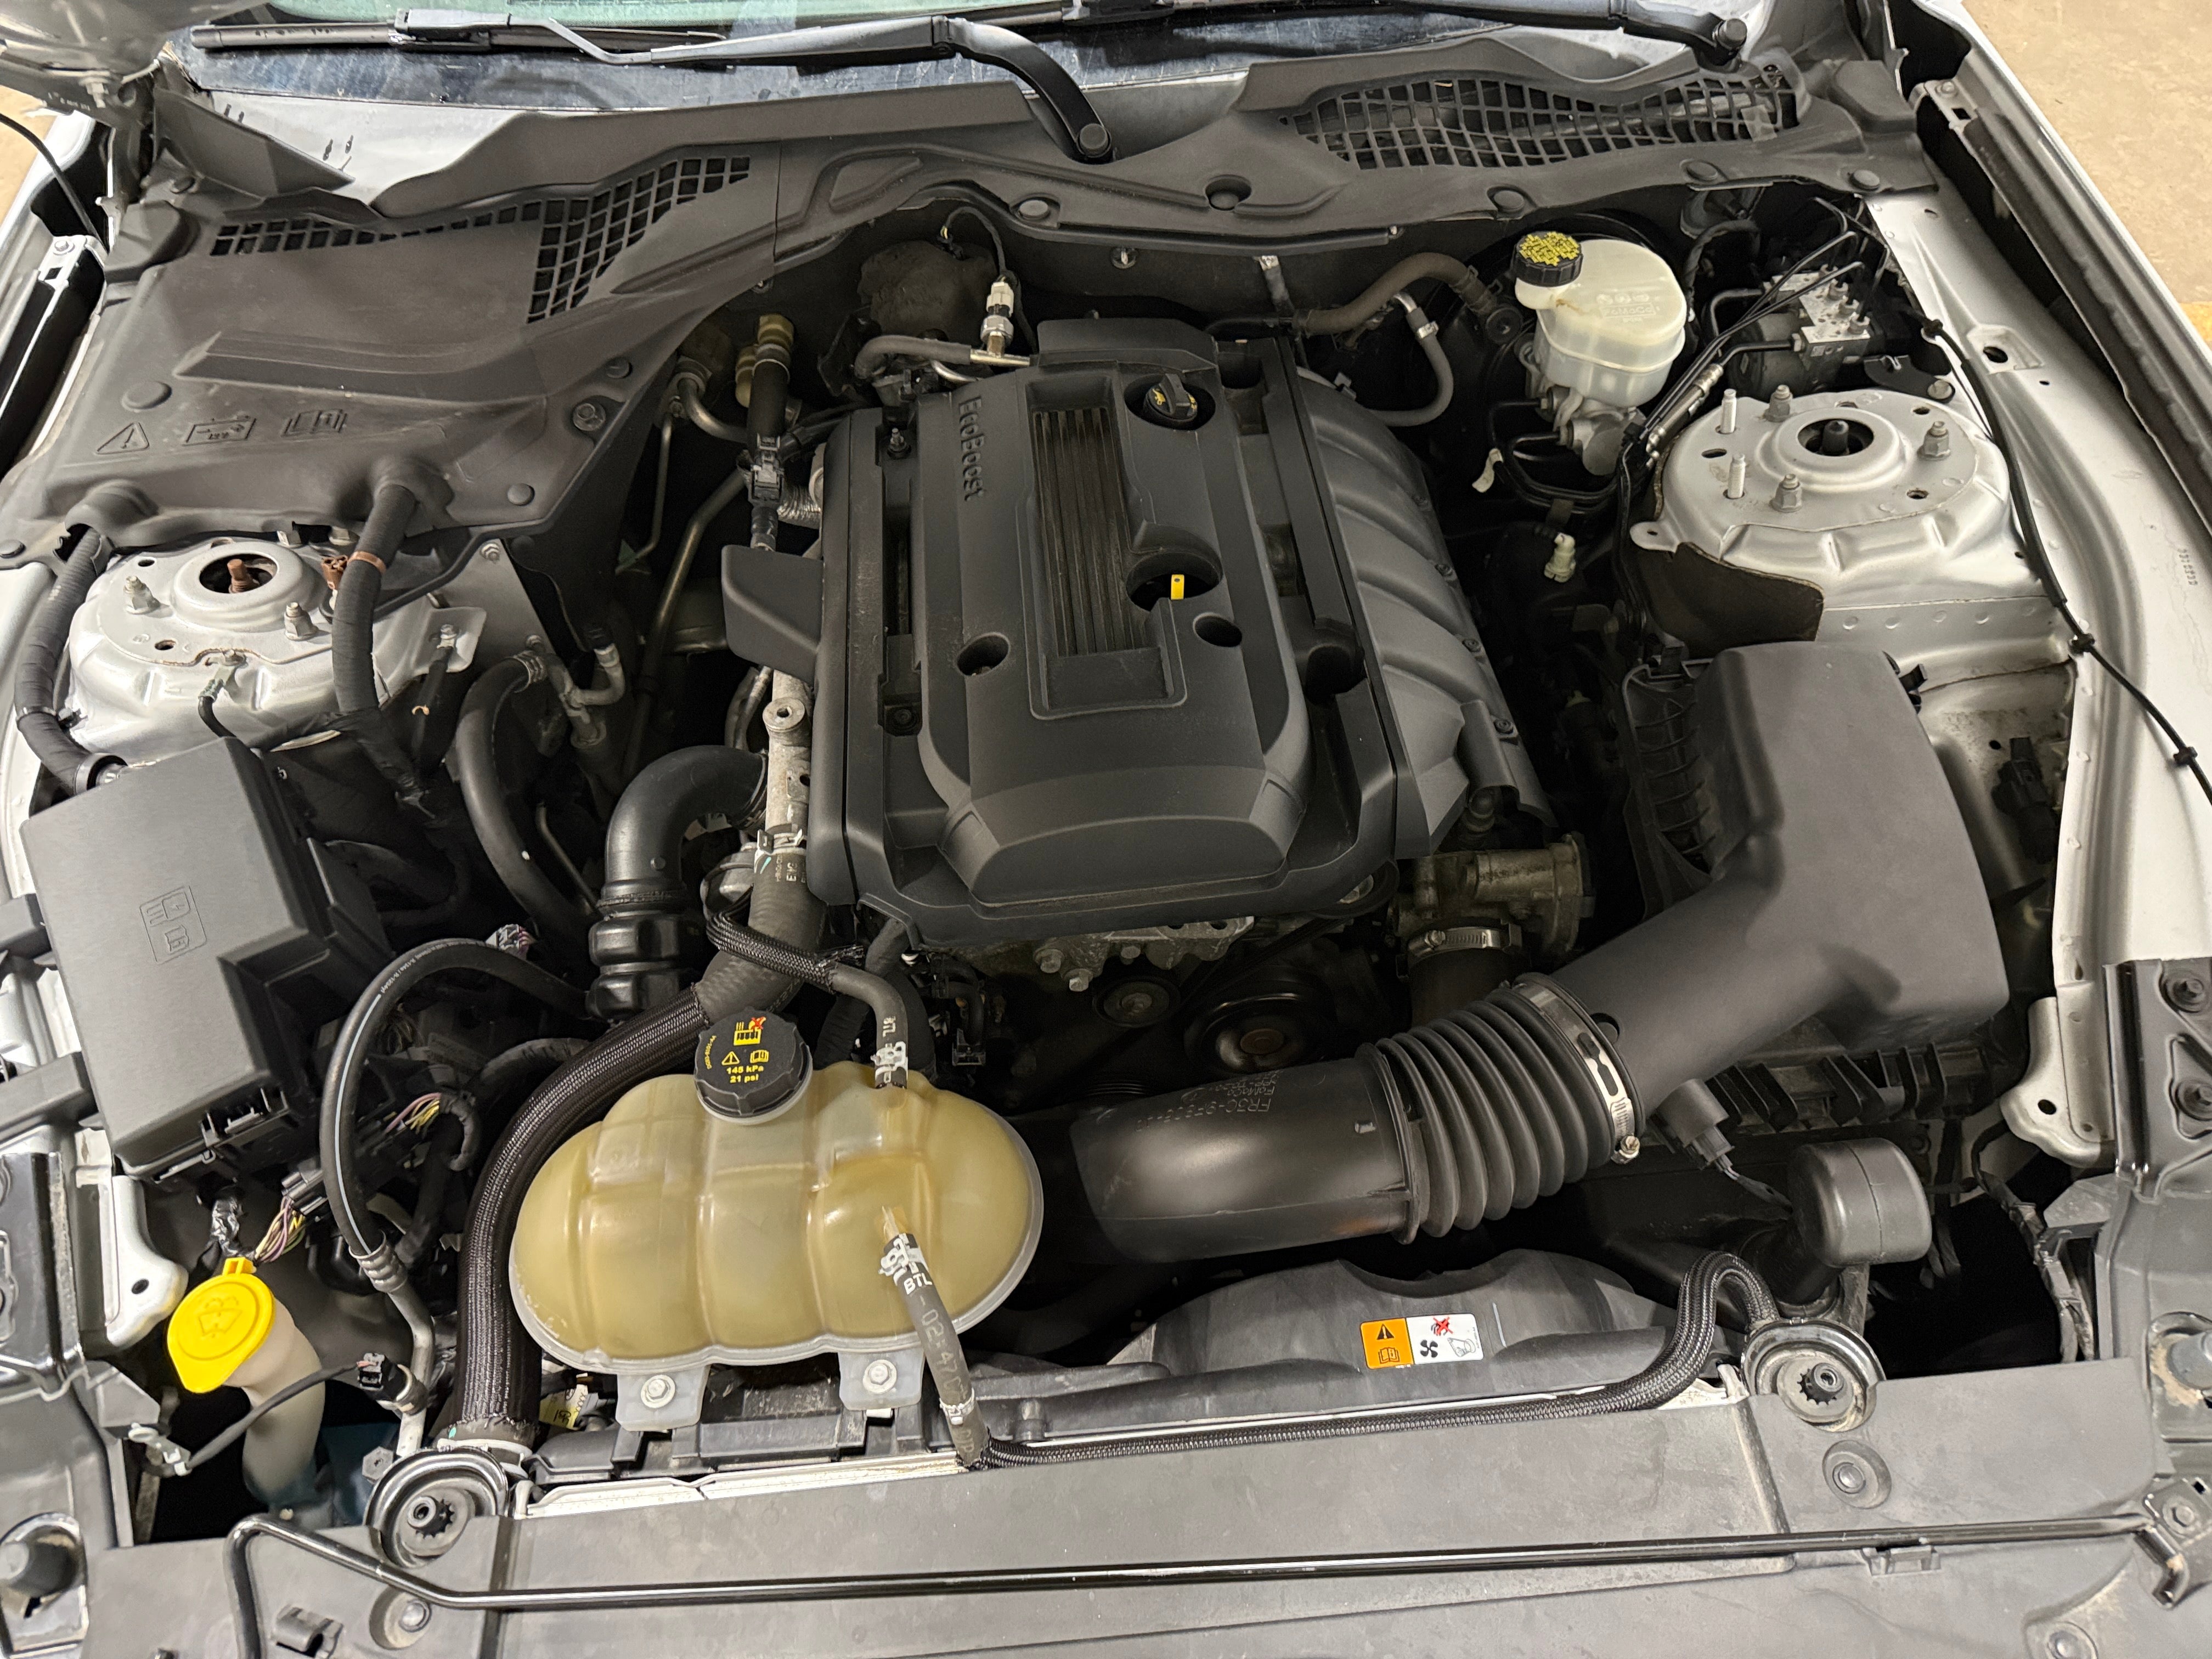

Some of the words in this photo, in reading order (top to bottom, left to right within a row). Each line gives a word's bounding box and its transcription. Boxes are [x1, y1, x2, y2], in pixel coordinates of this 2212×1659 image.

[958, 396, 986, 501] EcoBoost
[726, 1066, 744, 1074] 145
[746, 1065, 764, 1073] kPa
[744, 1074, 759, 1084] psi
[904, 1273, 933, 1295] BTL
